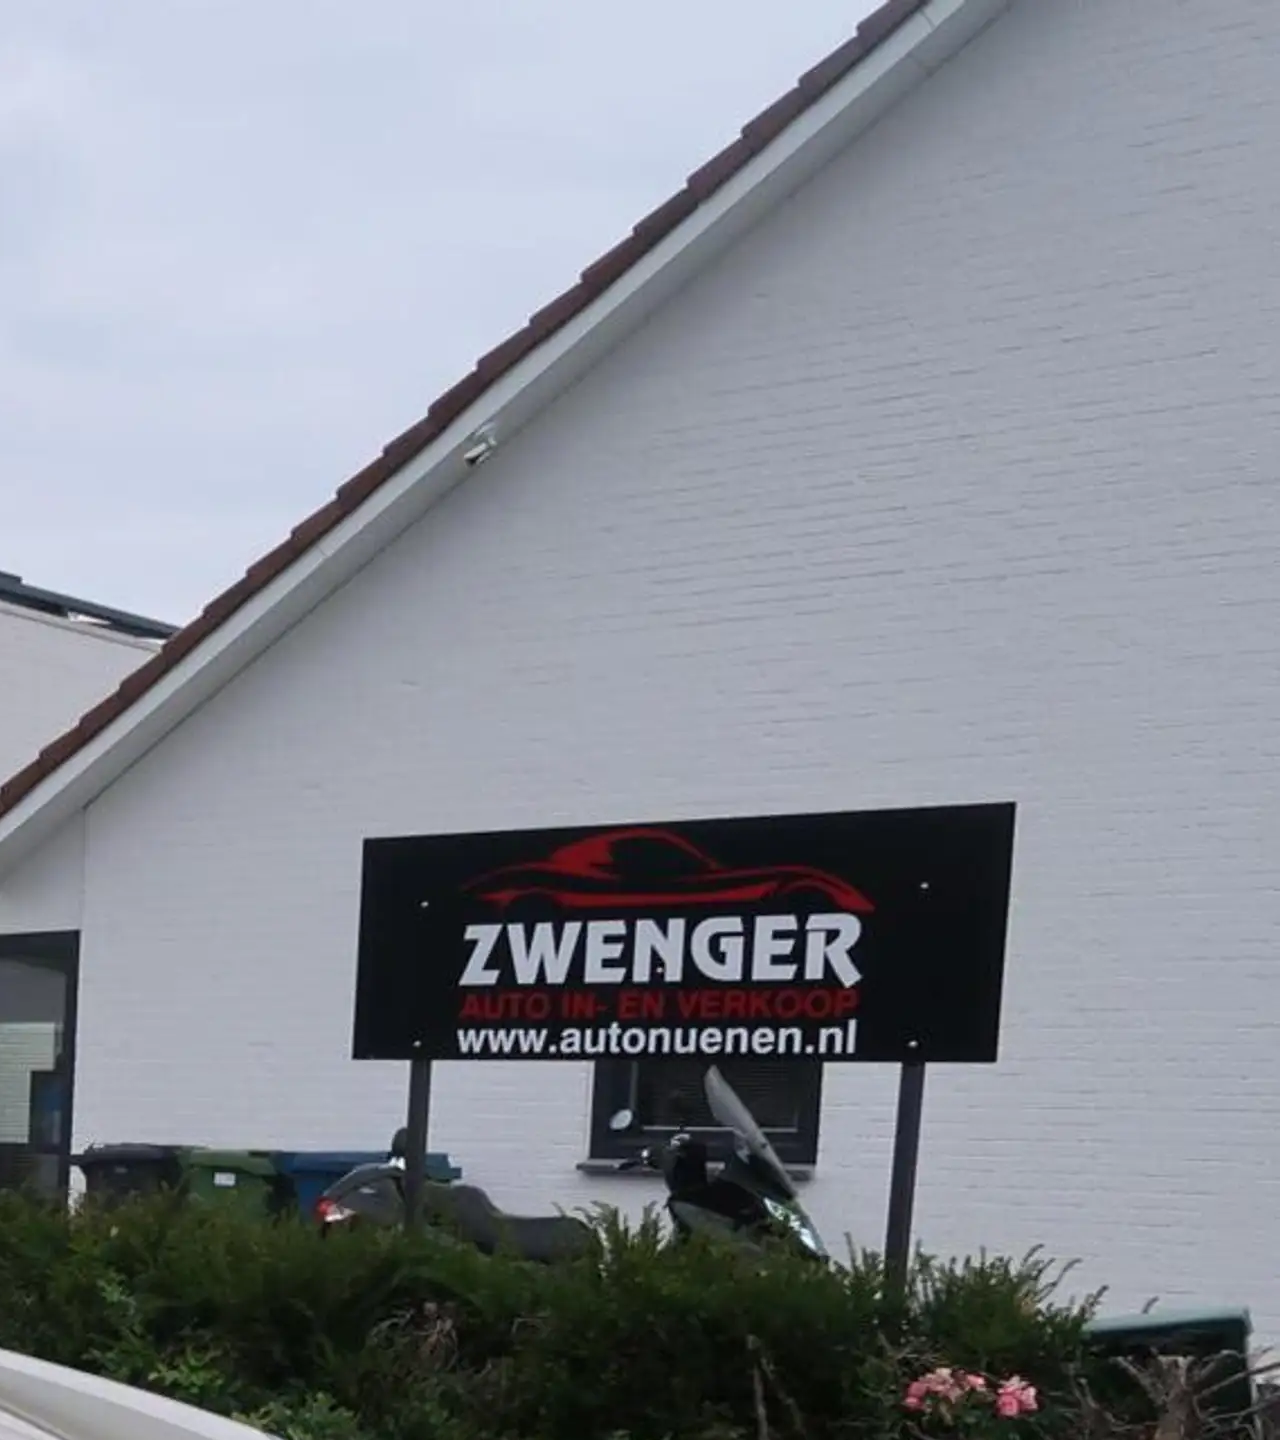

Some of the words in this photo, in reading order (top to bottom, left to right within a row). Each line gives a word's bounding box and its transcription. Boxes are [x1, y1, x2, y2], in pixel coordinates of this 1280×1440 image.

[458, 912, 862, 988] ZWENGER
[459, 992, 551, 1020] AUTO
[562, 992, 609, 1020] IN-
[618, 991, 664, 1019] EN
[677, 988, 861, 1019] VERKOOP
[457, 1019, 857, 1054] www.autonuenen.nl
